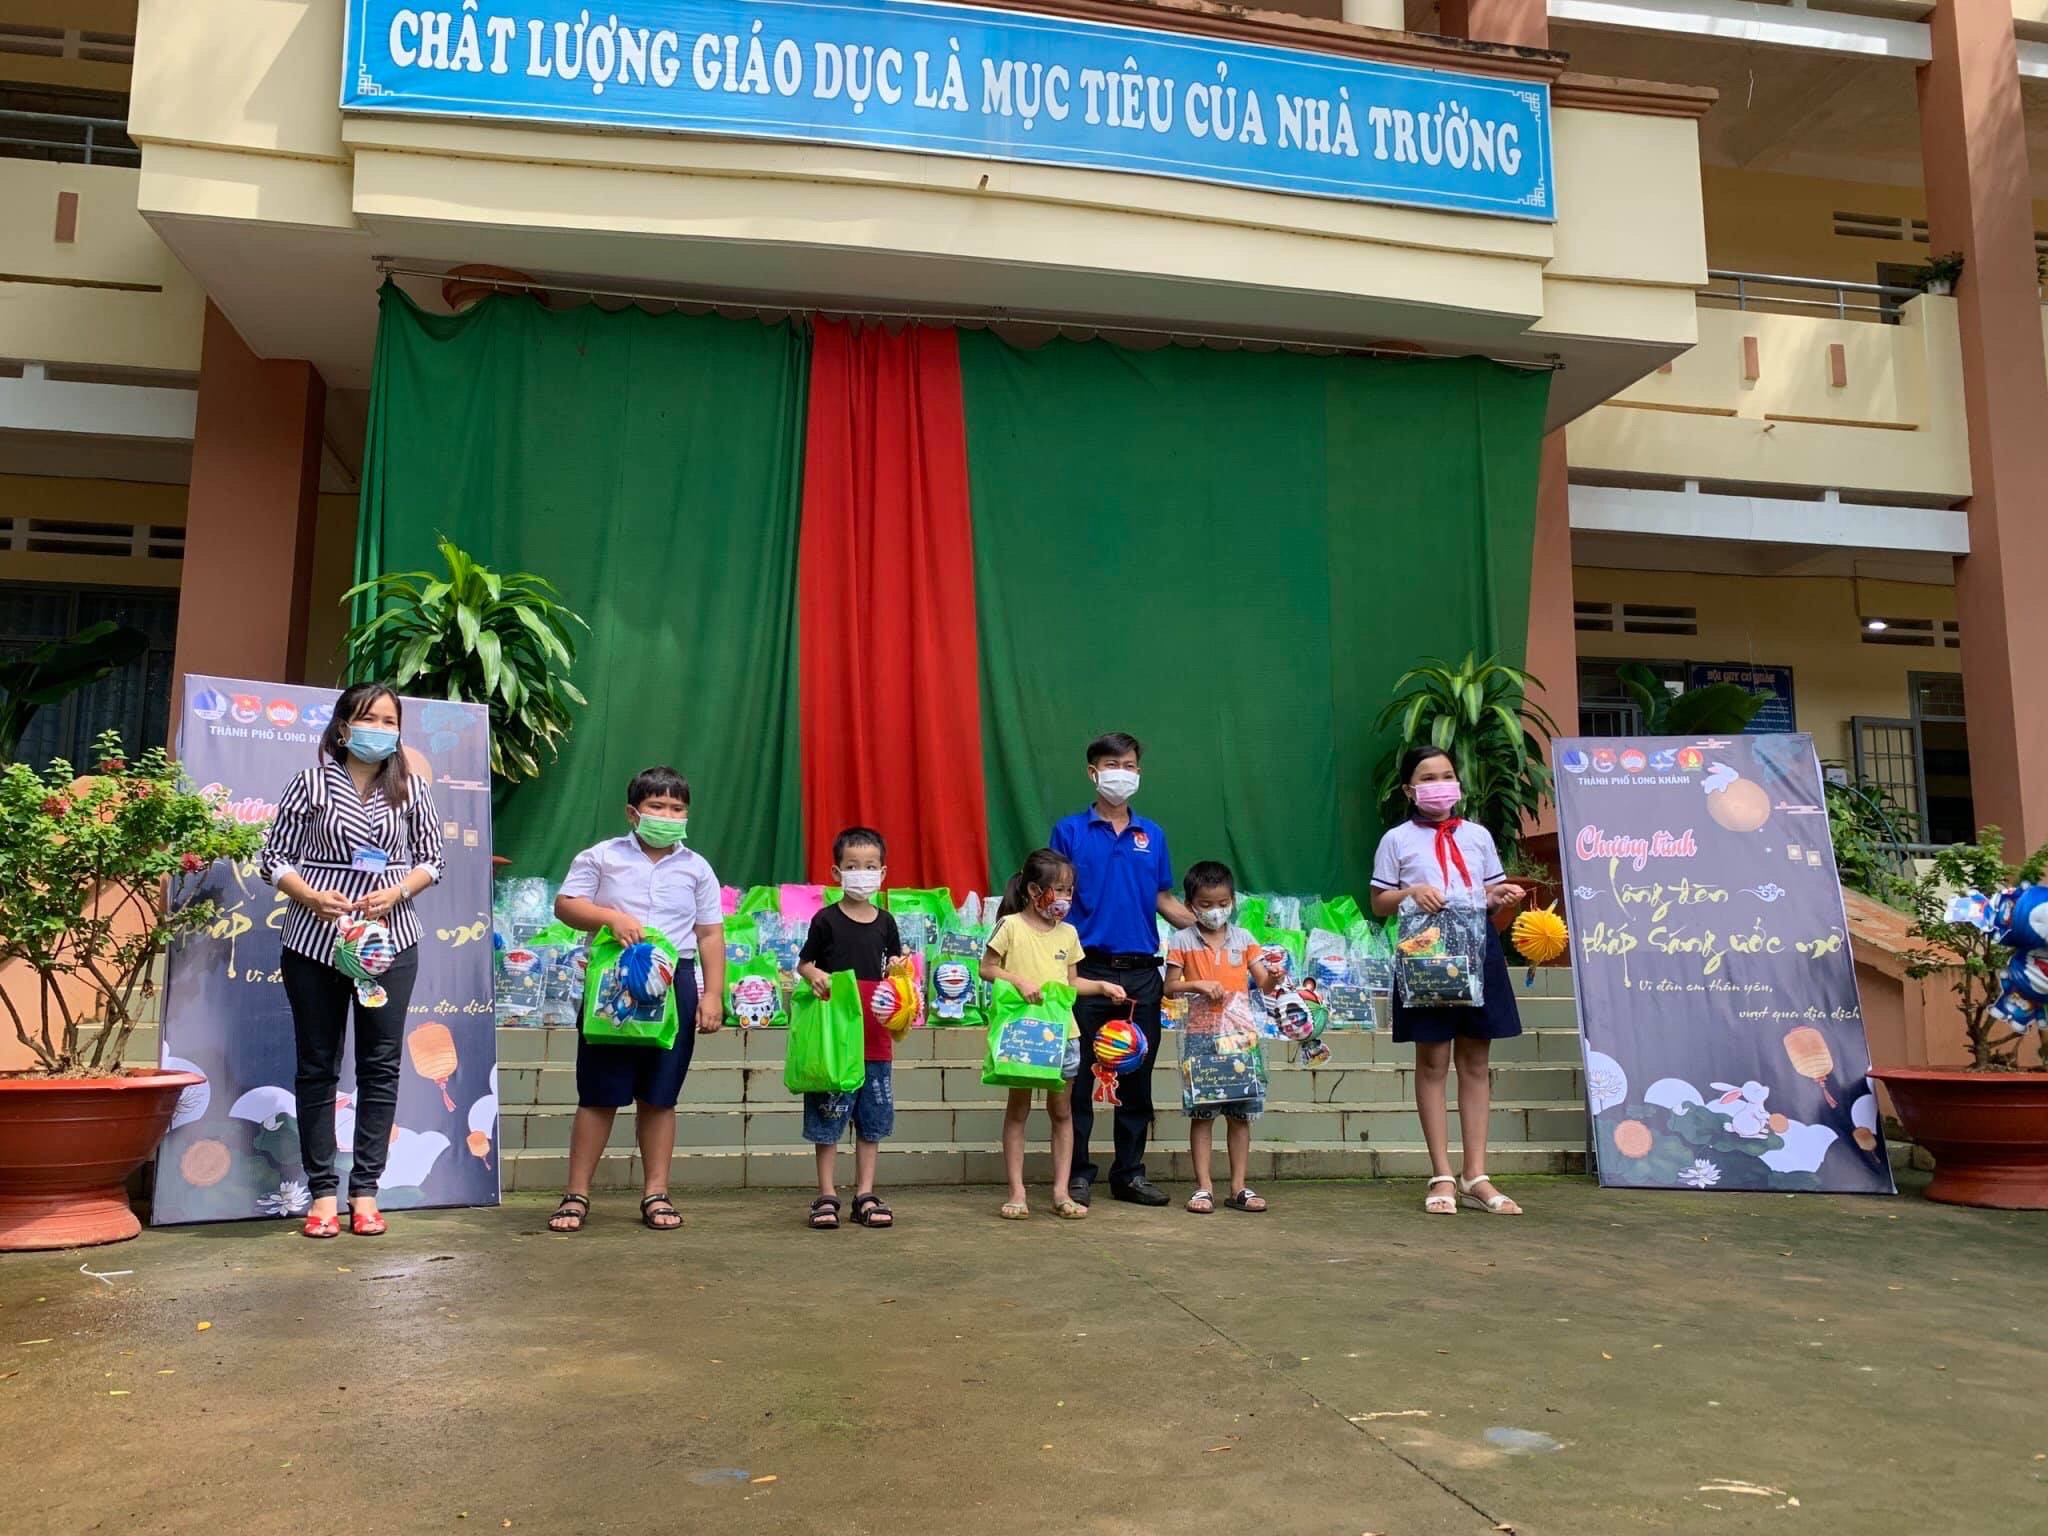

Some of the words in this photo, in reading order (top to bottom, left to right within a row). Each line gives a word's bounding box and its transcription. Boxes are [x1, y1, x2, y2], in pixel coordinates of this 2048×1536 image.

[526, 9, 681, 95] LƯỢNG
[692, 19, 803, 97] GIÁO
[813, 42, 903, 114] DỤC
[913, 36, 969, 112] LÀ
[981, 58, 1070, 131] MỤC
[1080, 55, 1175, 133] TIÊU
[1184, 60, 1267, 146] CỦA
[1276, 86, 1359, 157] NHÀ
[1368, 99, 1522, 176] TRƯỜNG
[209, 724, 248, 738] THÀNH
[252, 726, 274, 740] PHỐ
[277, 731, 306, 743] LONG
[1578, 775, 1609, 786] THÀNH
[1611, 774, 1630, 786] PHỐ
[1632, 776, 1657, 785] LONG
[1658, 774, 1690, 785] KHÁNH
[1576, 825, 1649, 872] Chương
[1648, 829, 1698, 857] trình
[463, 999, 494, 1017] dịch
[1772, 1010, 1799, 1023] qua
[1830, 1005, 1860, 1022] dịch
